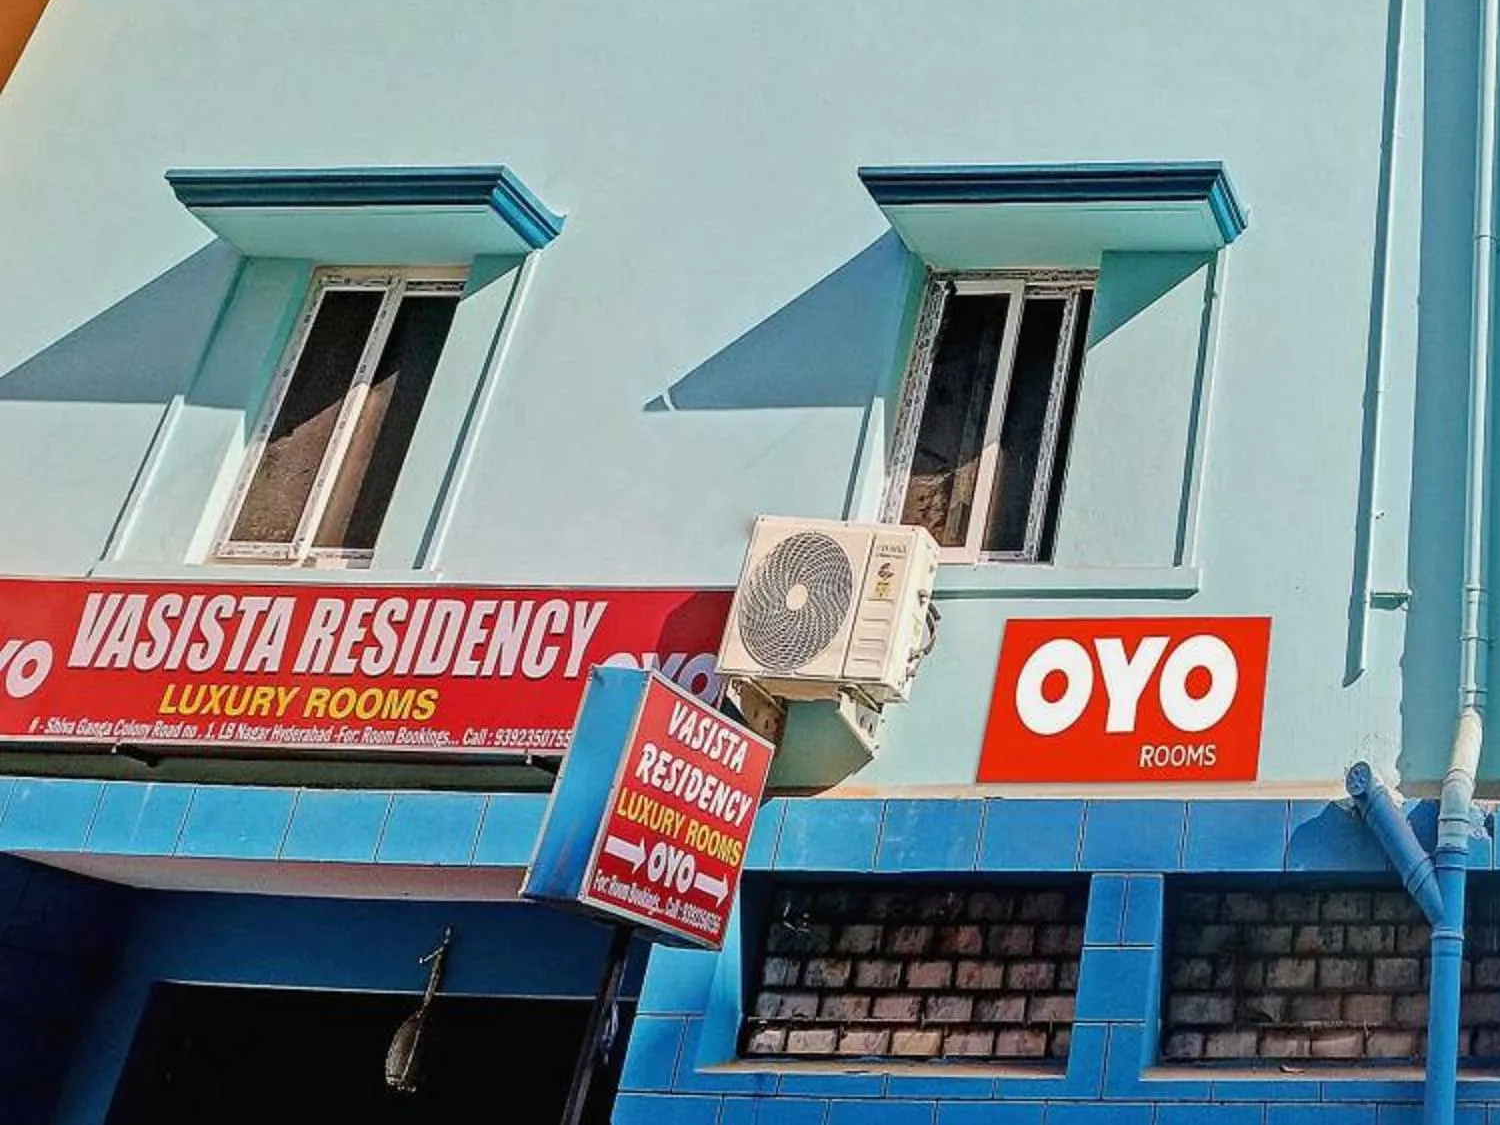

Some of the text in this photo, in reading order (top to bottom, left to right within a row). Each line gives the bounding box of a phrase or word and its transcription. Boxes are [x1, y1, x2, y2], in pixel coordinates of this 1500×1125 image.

[67, 592, 608, 678] VASISTA RESIDENCY
[158, 683, 440, 720] LUXURY ROOMS
[1015, 634, 1239, 735] OYO
[44, 717, 76, 735] Shiva
[113, 718, 151, 739] Colony
[150, 720, 182, 739] Road
[234, 723, 272, 743] Nagar
[271, 724, 332, 744] Hyderabad
[361, 726, 396, 745] Room
[667, 701, 749, 774] VASISTA
[1139, 744, 1217, 768] ROOMS
[635, 743, 753, 827] RESIDENCY
[616, 787, 743, 867] LUXURY ROOMS
[647, 842, 696, 894] OYO
